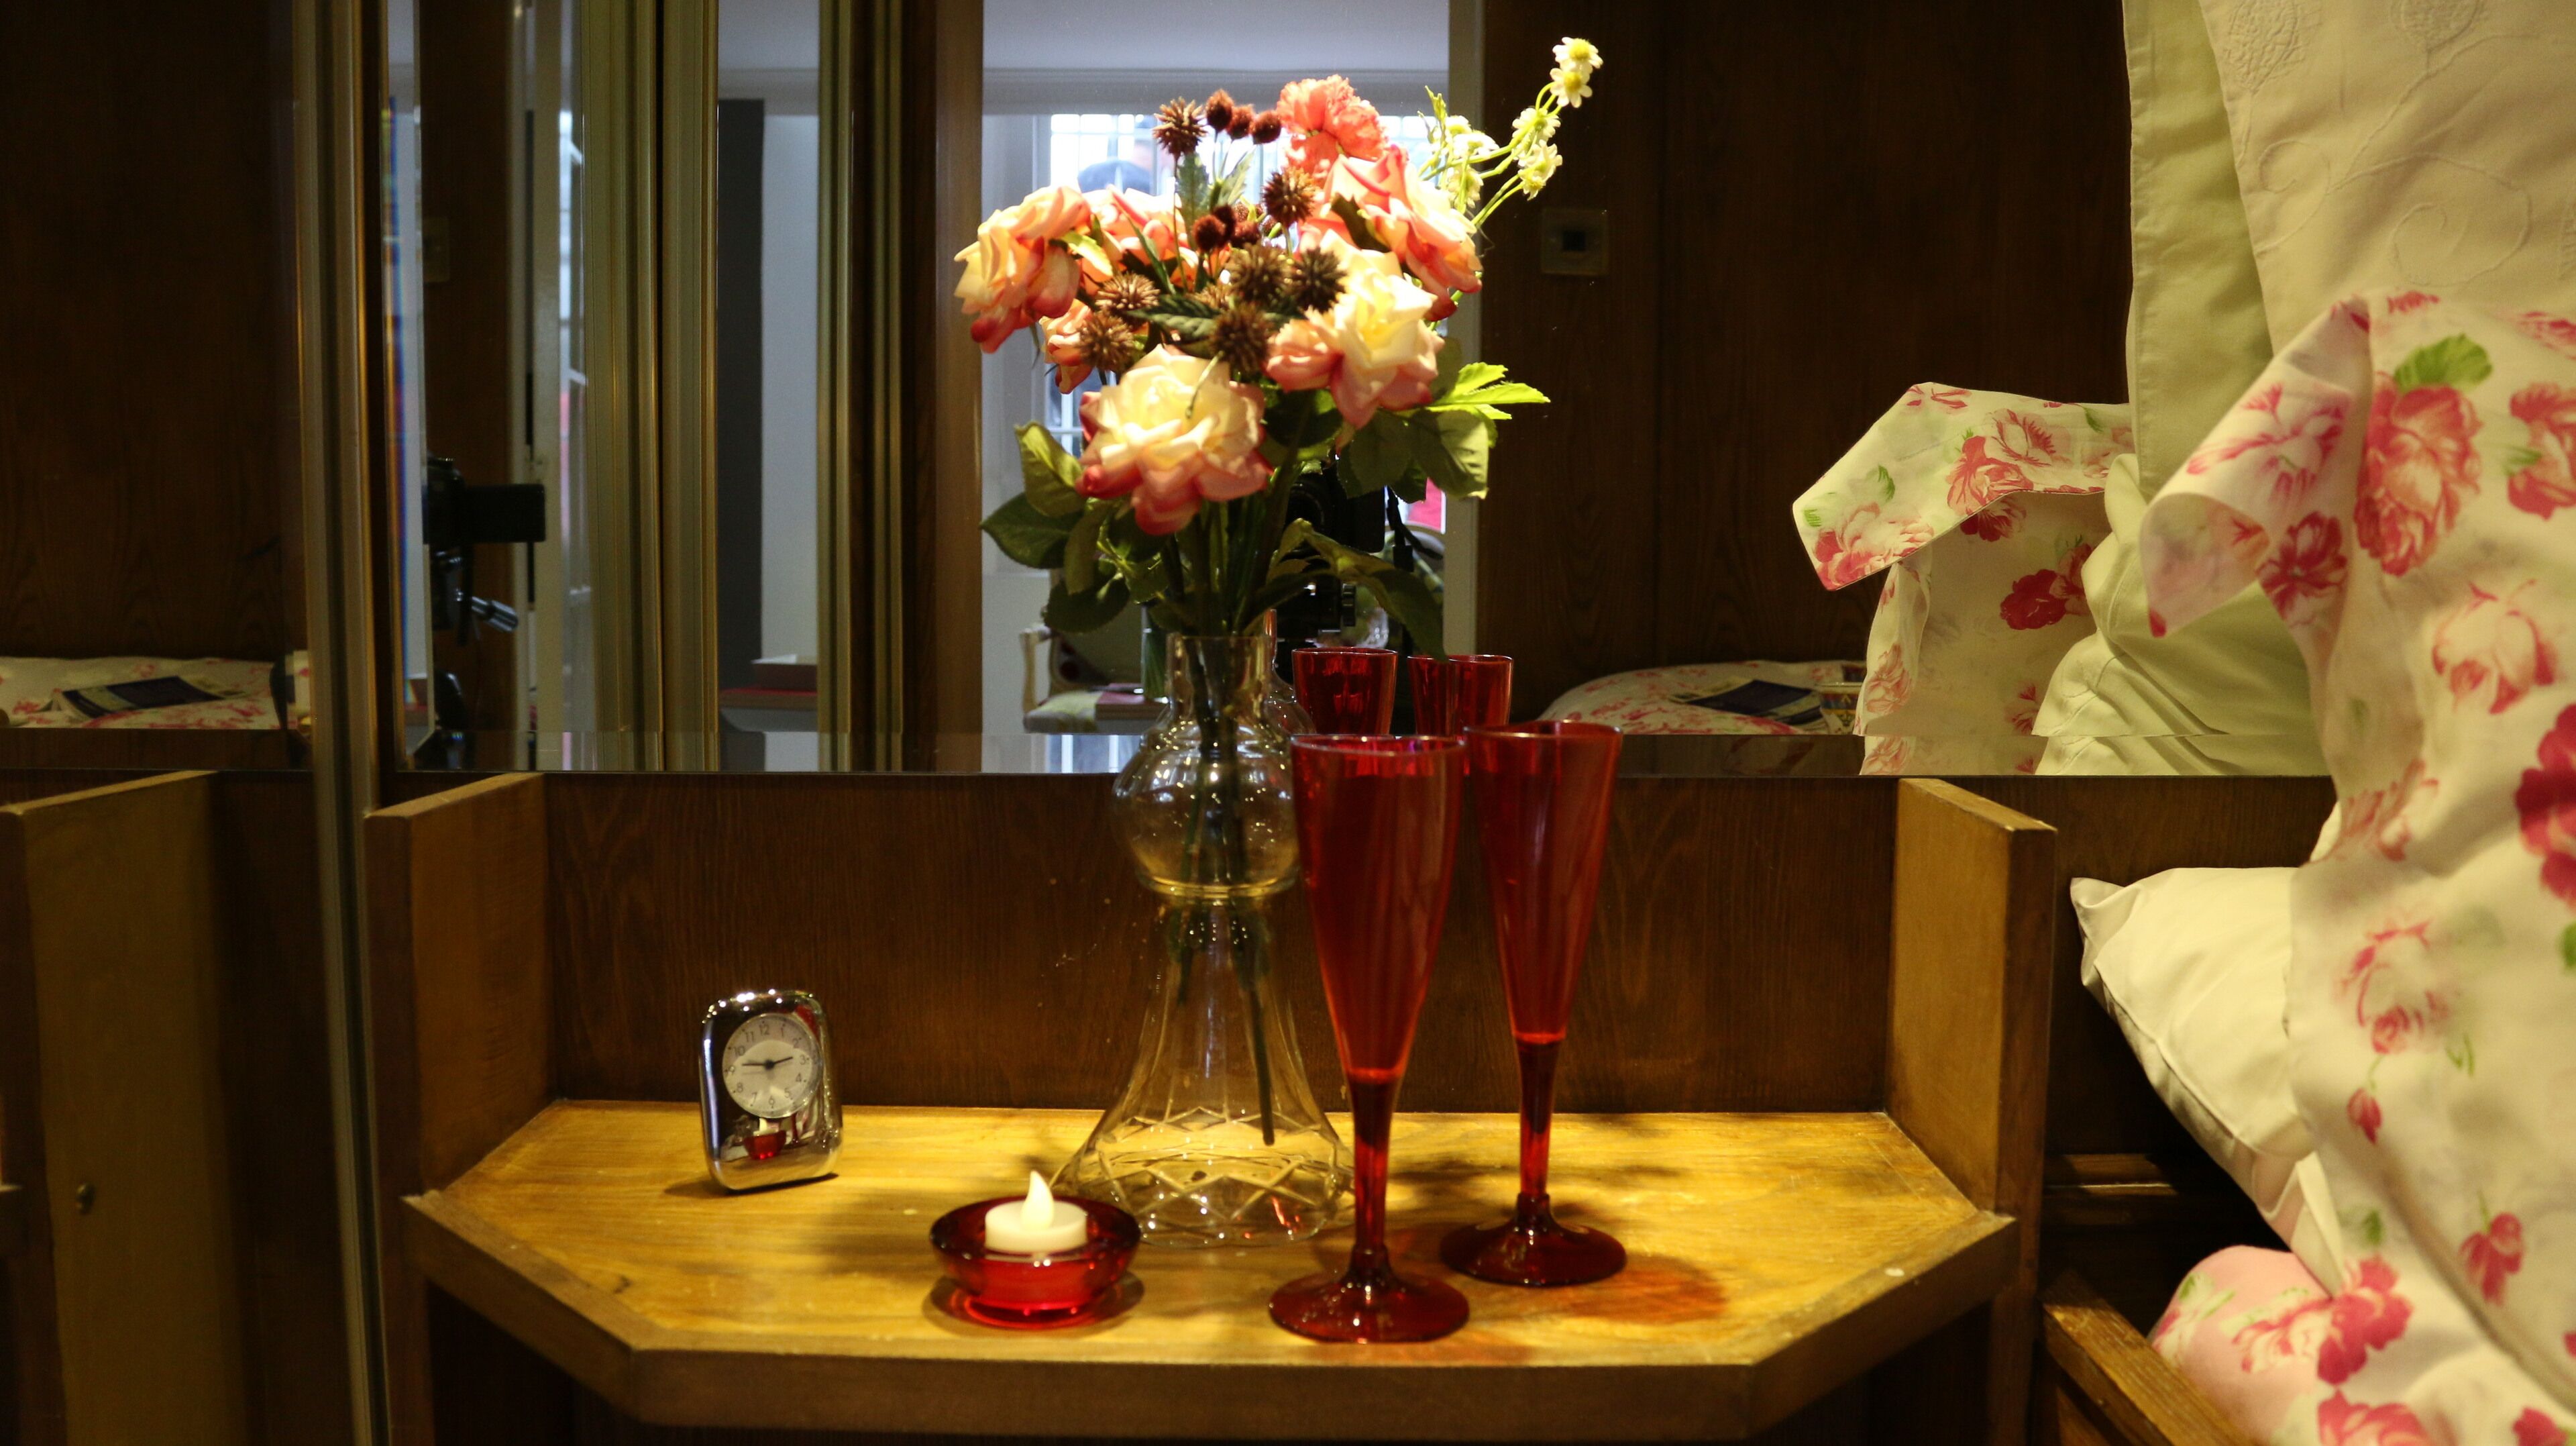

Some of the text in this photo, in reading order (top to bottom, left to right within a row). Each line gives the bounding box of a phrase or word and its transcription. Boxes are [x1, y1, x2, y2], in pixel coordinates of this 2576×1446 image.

[759, 1024, 769, 1035] 12
[780, 1027, 784, 1037] 1
[745, 1031, 754, 1042] 11
[792, 1038, 799, 1048] 2
[733, 1045, 745, 1056] 10
[799, 1055, 806, 1065] 3
[729, 1065, 735, 1075] 9
[796, 1073, 802, 1082] 4
[737, 1082, 743, 1093] 8
[784, 1087, 790, 1098] 5
[751, 1092, 757, 1104] 7
[768, 1094, 775, 1106] 6
